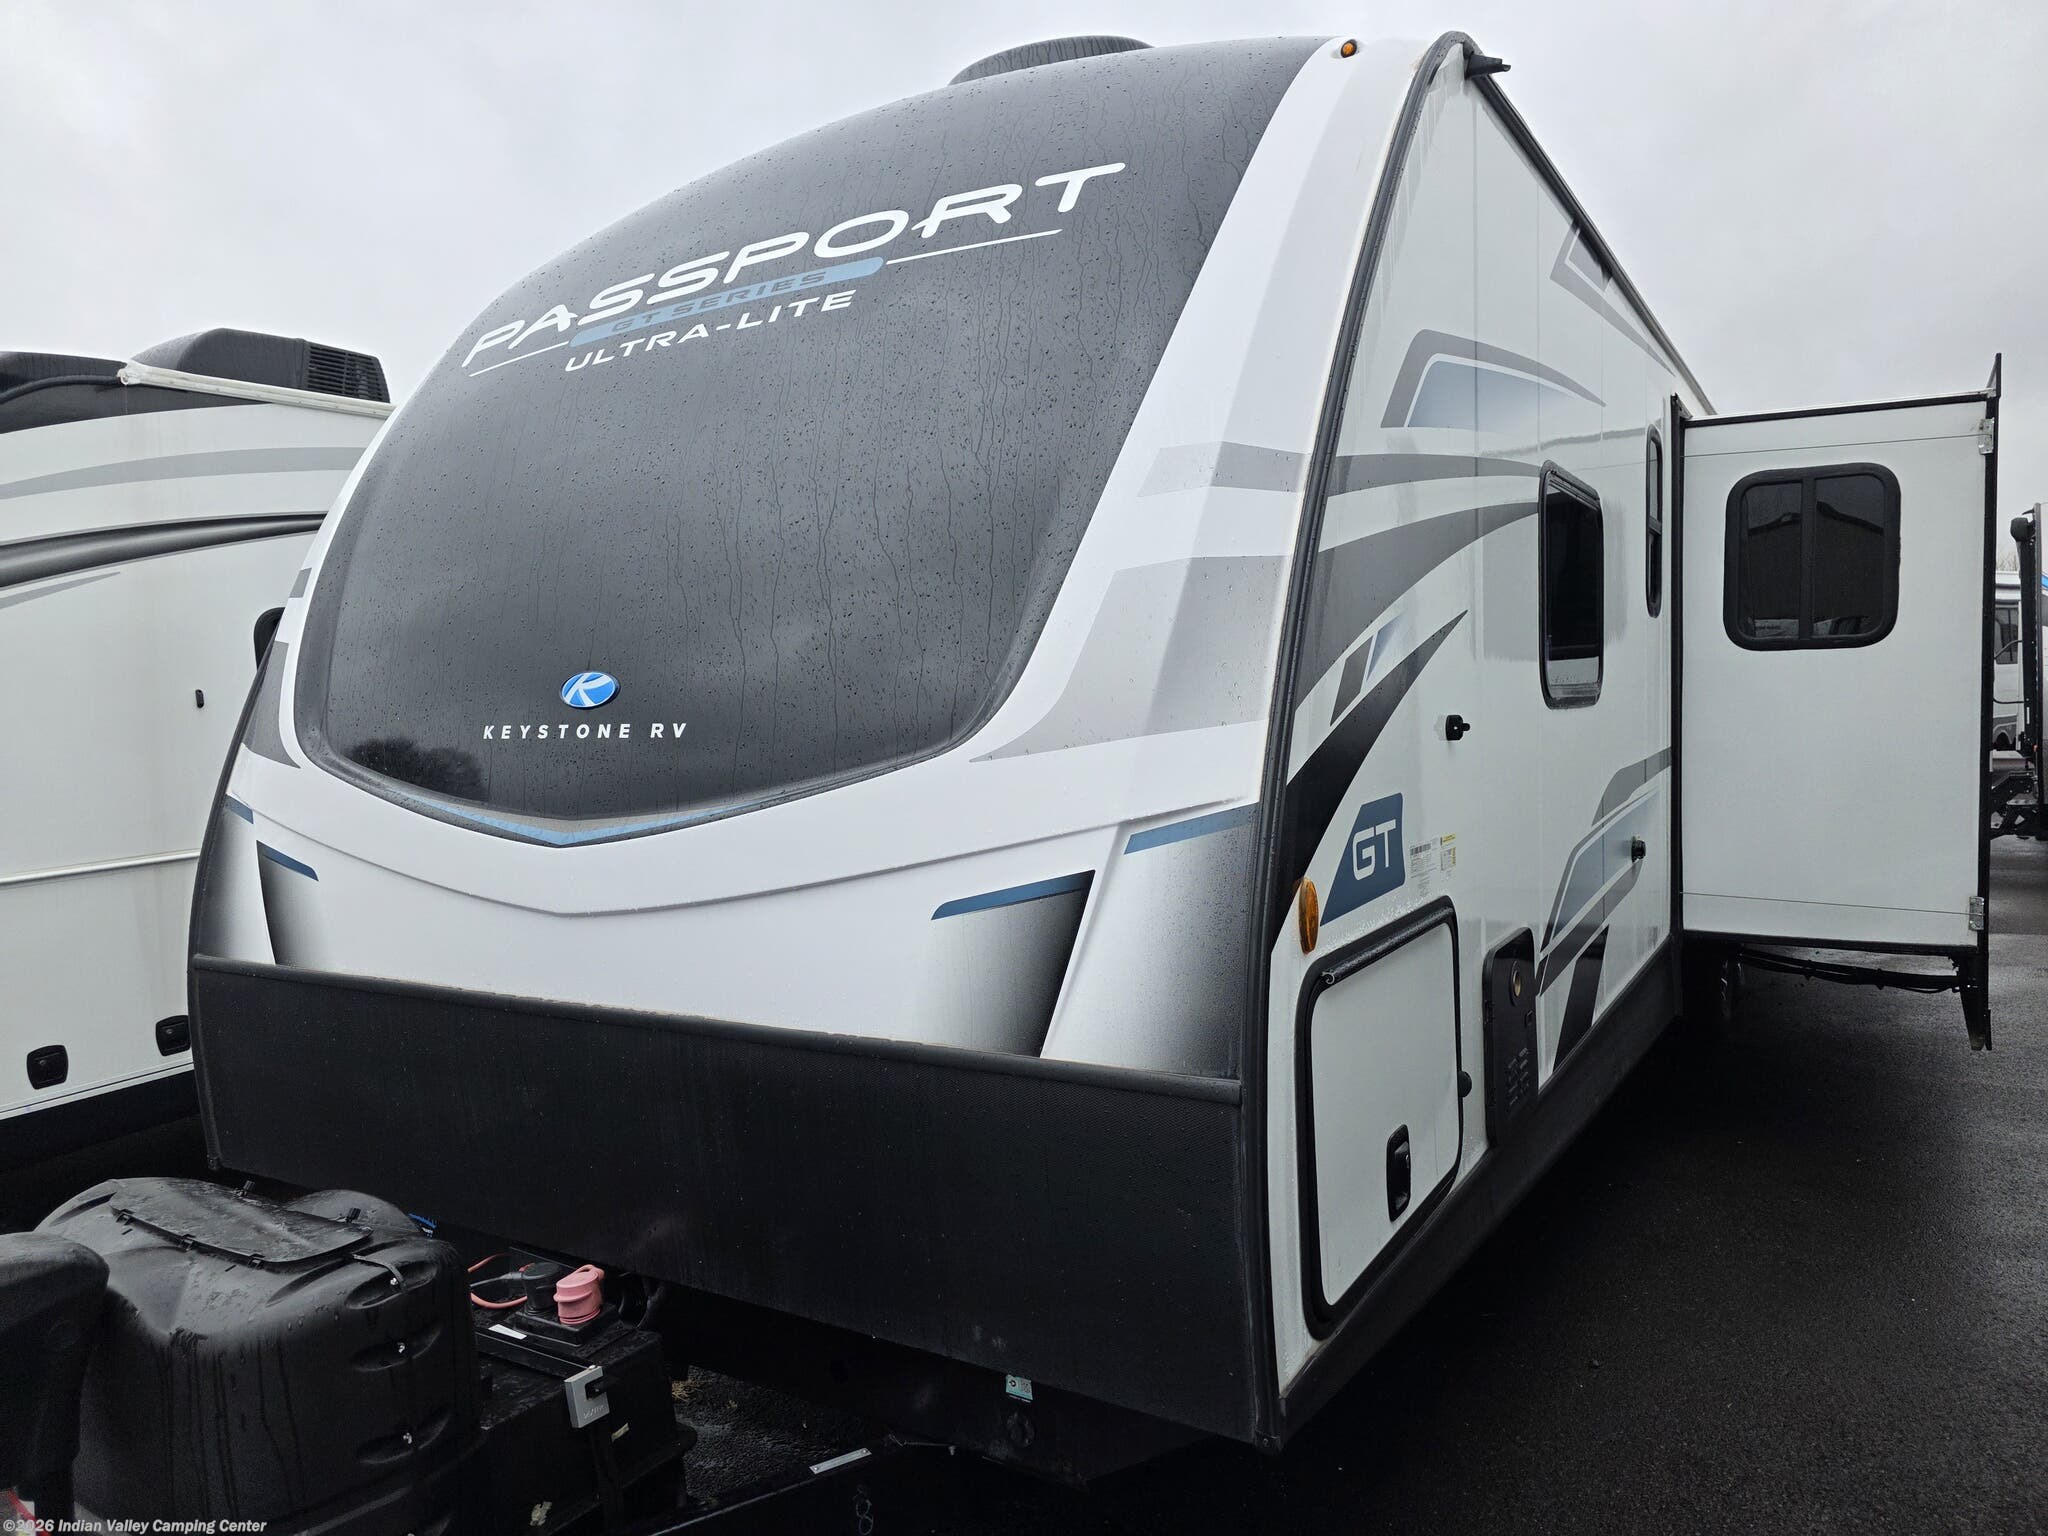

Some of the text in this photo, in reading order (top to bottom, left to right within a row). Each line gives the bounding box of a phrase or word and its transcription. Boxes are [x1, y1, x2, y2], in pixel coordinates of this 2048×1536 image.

[461, 162, 1126, 368] PASSPORT
[565, 289, 857, 372] ULTRA-LITE
[611, 271, 827, 333] GT SERIES
[483, 722, 687, 740] KEYSTONE RV
[1353, 819, 1397, 881] GT
